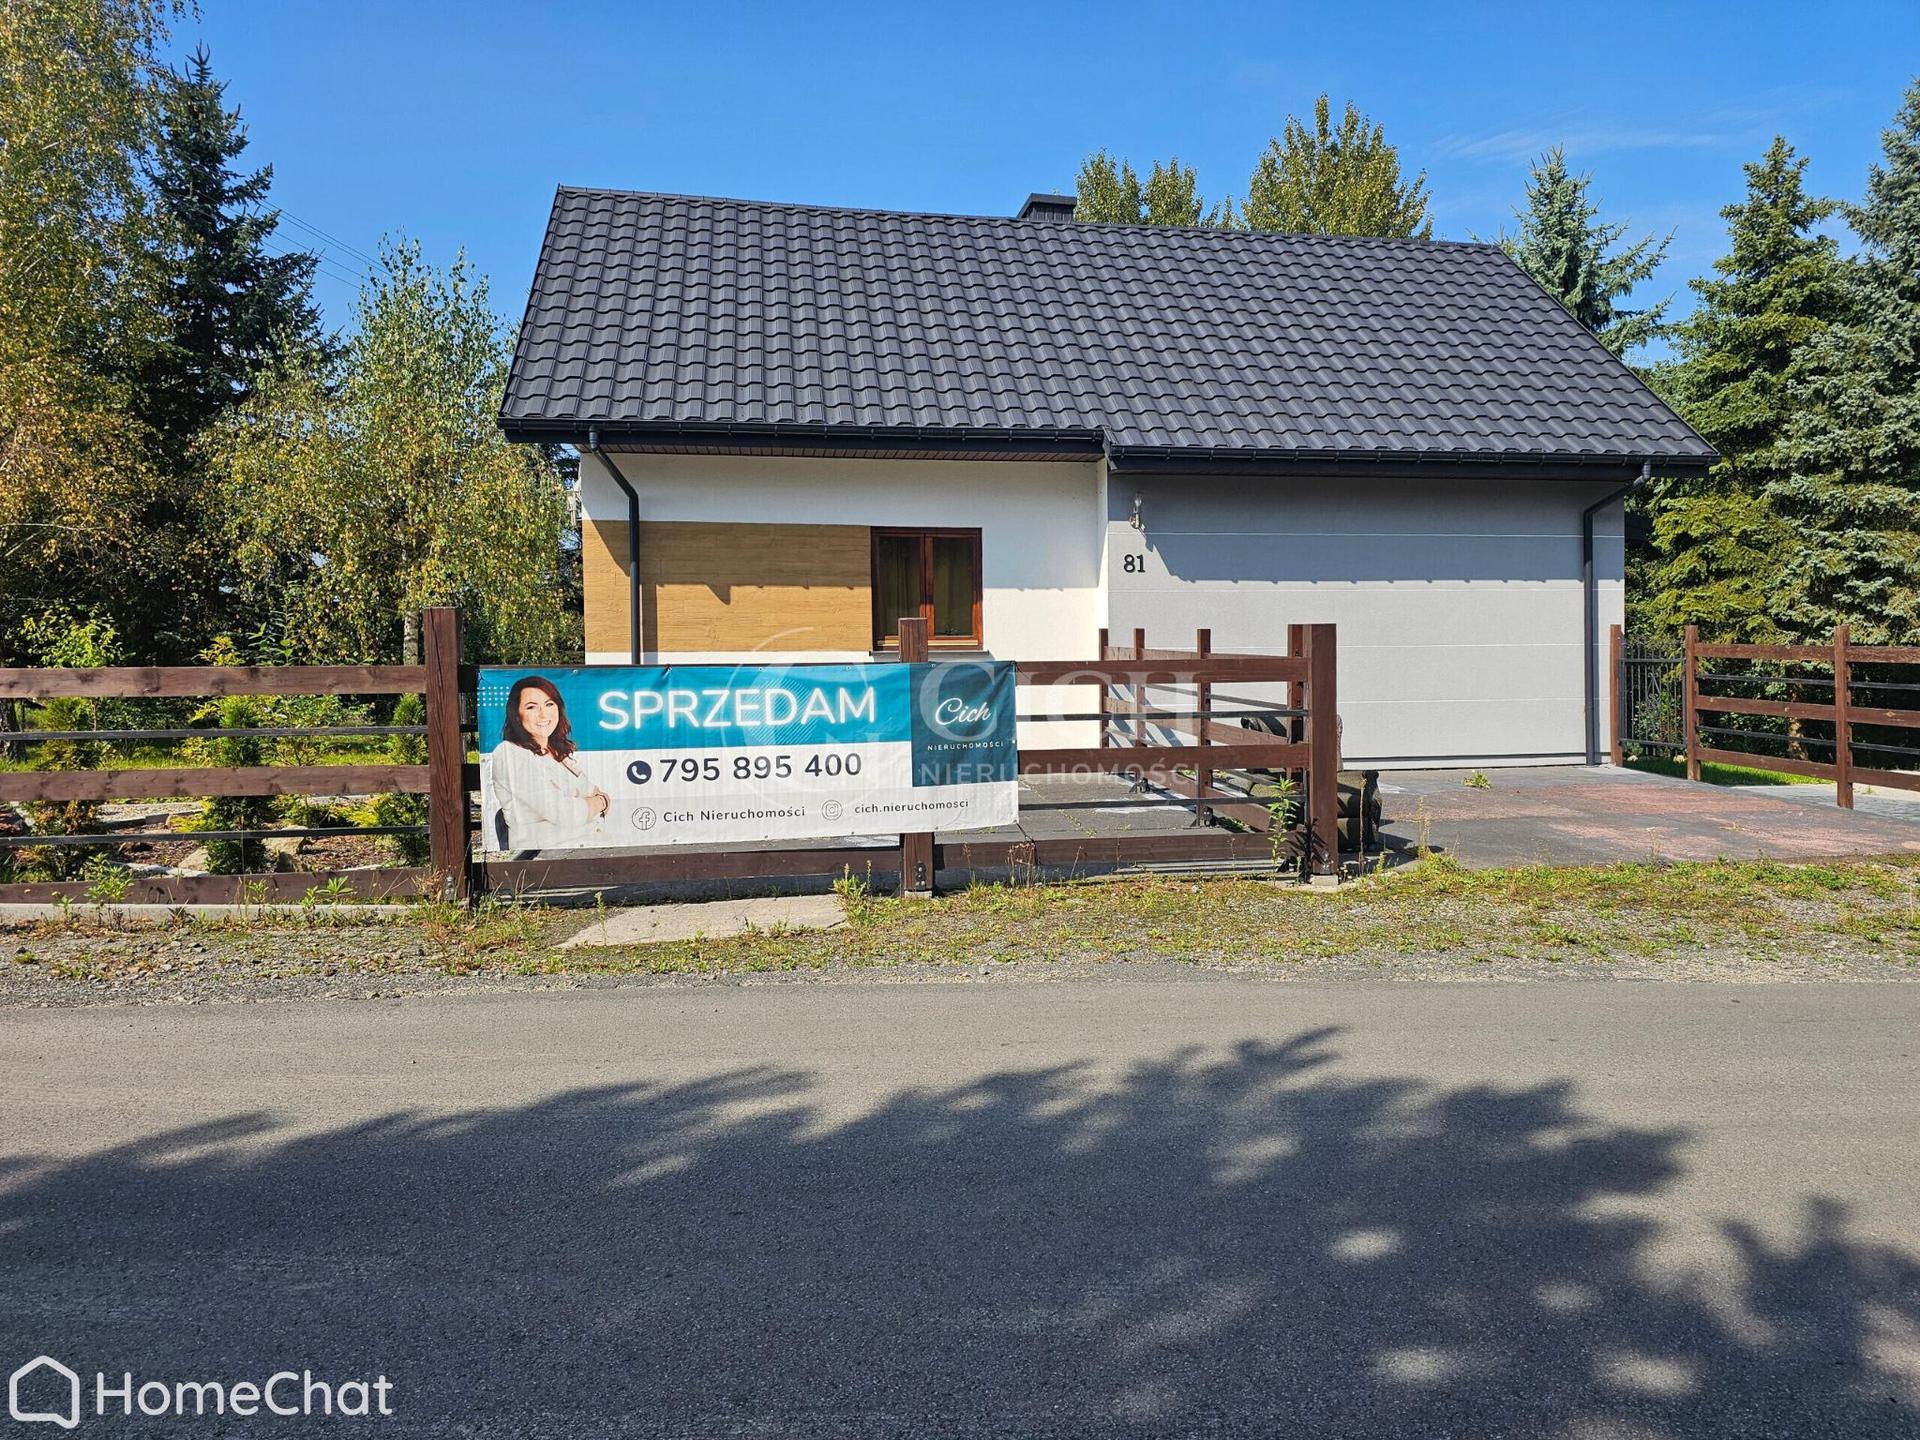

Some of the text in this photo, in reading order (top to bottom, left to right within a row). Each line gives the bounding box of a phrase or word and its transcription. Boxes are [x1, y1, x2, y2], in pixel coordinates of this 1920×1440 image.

[1123, 553, 1146, 573] 81
[598, 685, 876, 731] SPRZEDAM
[935, 697, 992, 726] Cich
[927, 740, 1004, 751] NIERUCHOMOŚCI
[660, 752, 862, 782] 795 895 400
[663, 806, 806, 823] Cich Nieruchomości
[854, 798, 969, 814] cich.nieruchomosci
